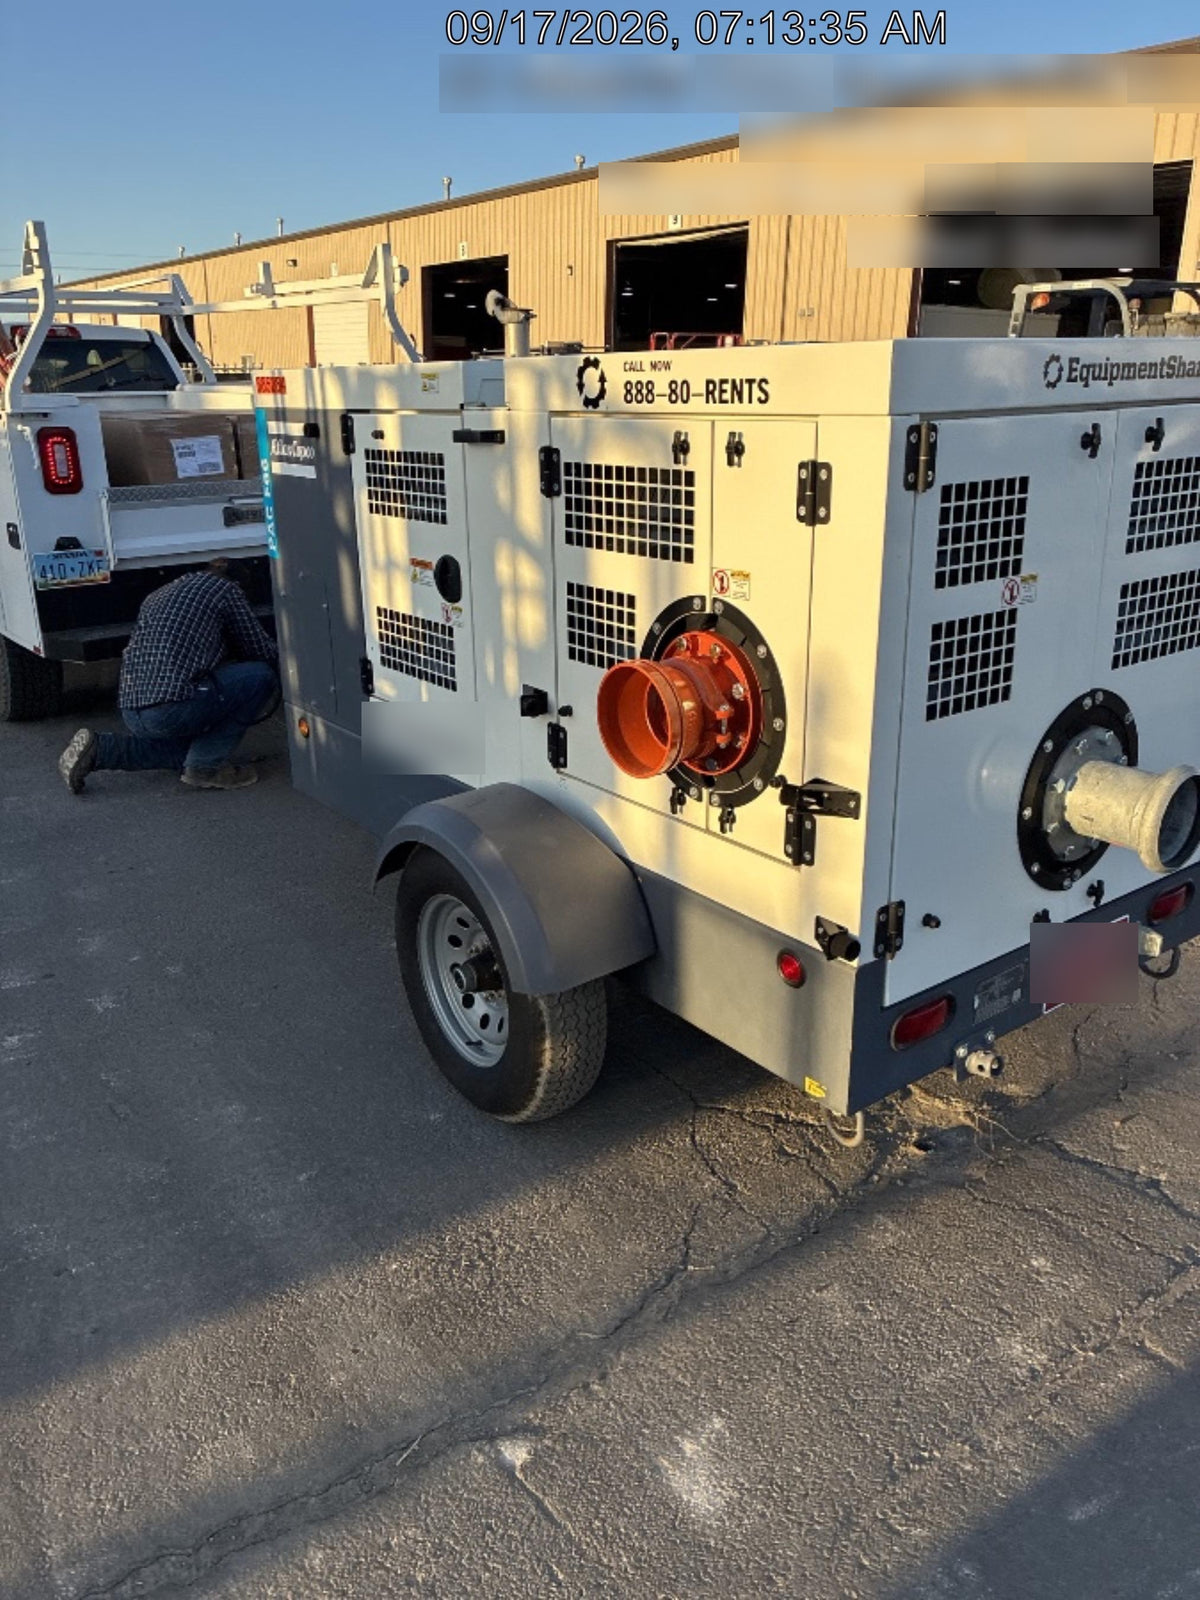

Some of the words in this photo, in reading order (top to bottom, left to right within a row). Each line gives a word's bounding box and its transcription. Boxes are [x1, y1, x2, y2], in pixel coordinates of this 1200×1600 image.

[623, 360, 646, 373] CALL
[650, 359, 673, 372] NOW
[623, 377, 770, 405] 888-80-RENTS
